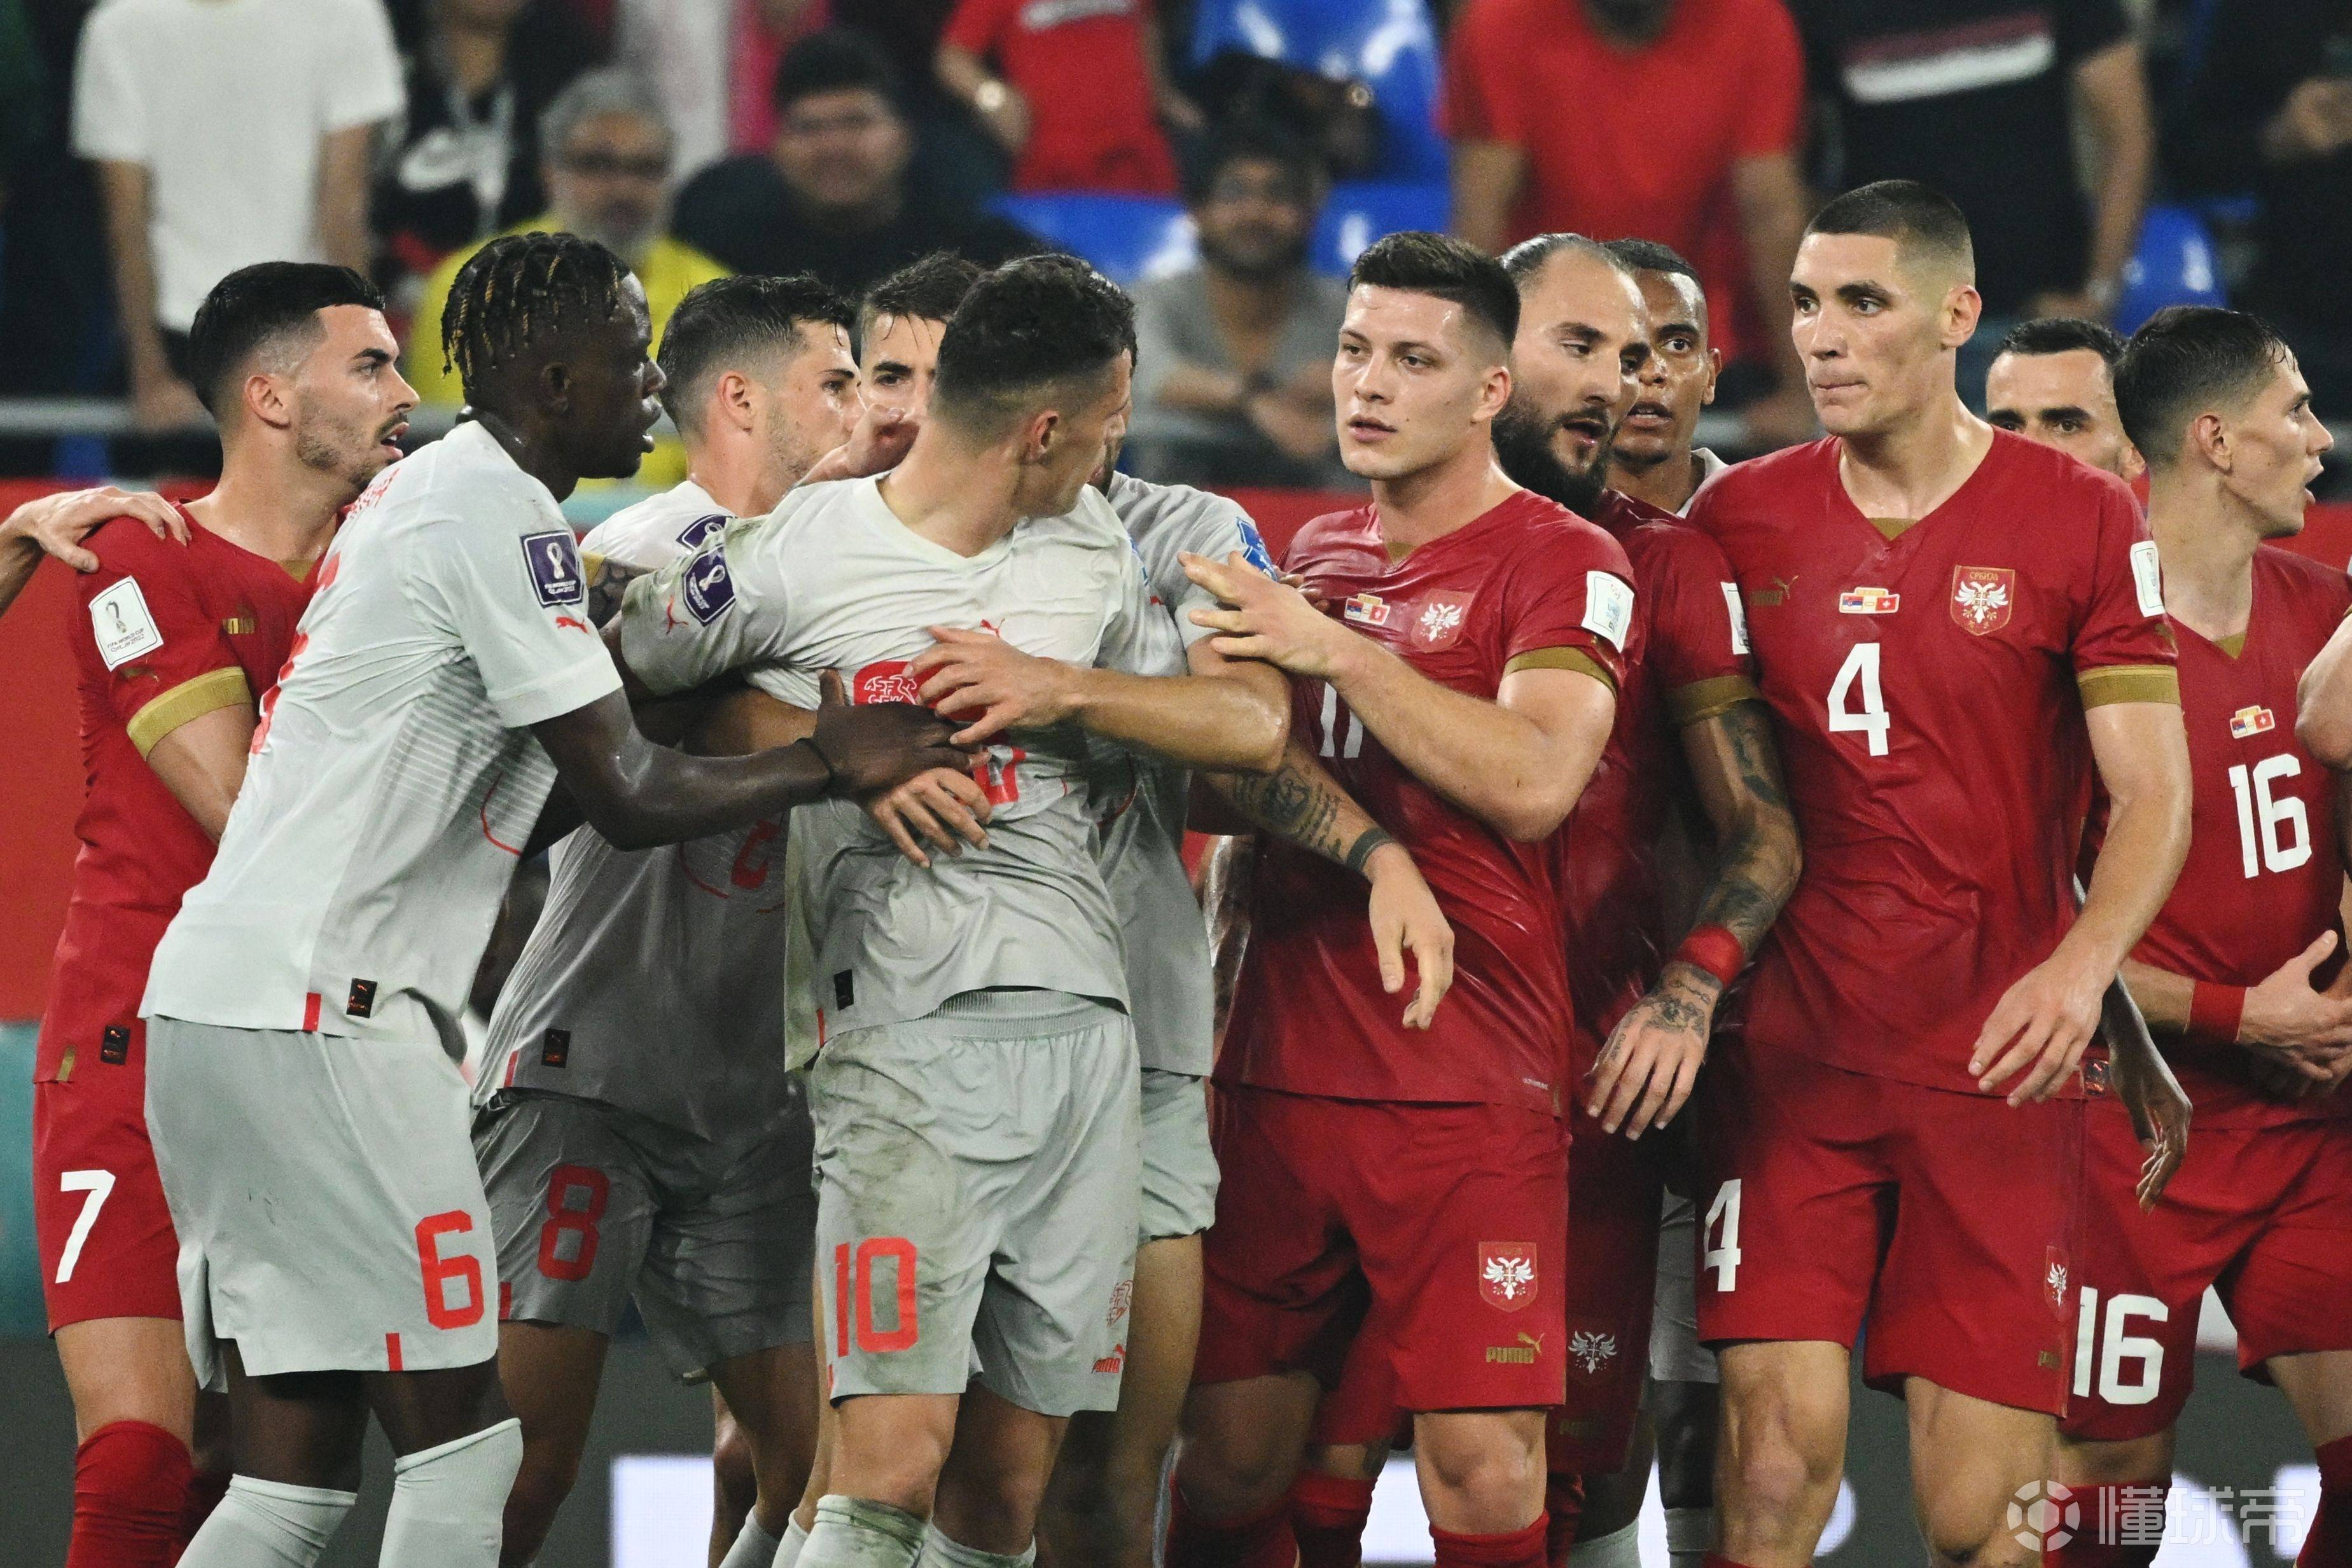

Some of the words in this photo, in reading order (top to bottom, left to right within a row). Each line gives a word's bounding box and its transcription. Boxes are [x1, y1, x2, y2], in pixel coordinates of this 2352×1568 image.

[1827, 642, 1891, 756] 4
[2229, 753, 2313, 879] 16
[55, 1169, 116, 1284] 7
[415, 1210, 484, 1330] 6
[538, 1165, 609, 1280] 8
[1704, 1179, 1742, 1292] 4
[834, 1237, 919, 1357] 10
[2073, 1286, 2169, 1405] 16
[1486, 1347, 1534, 1364] PUMA
